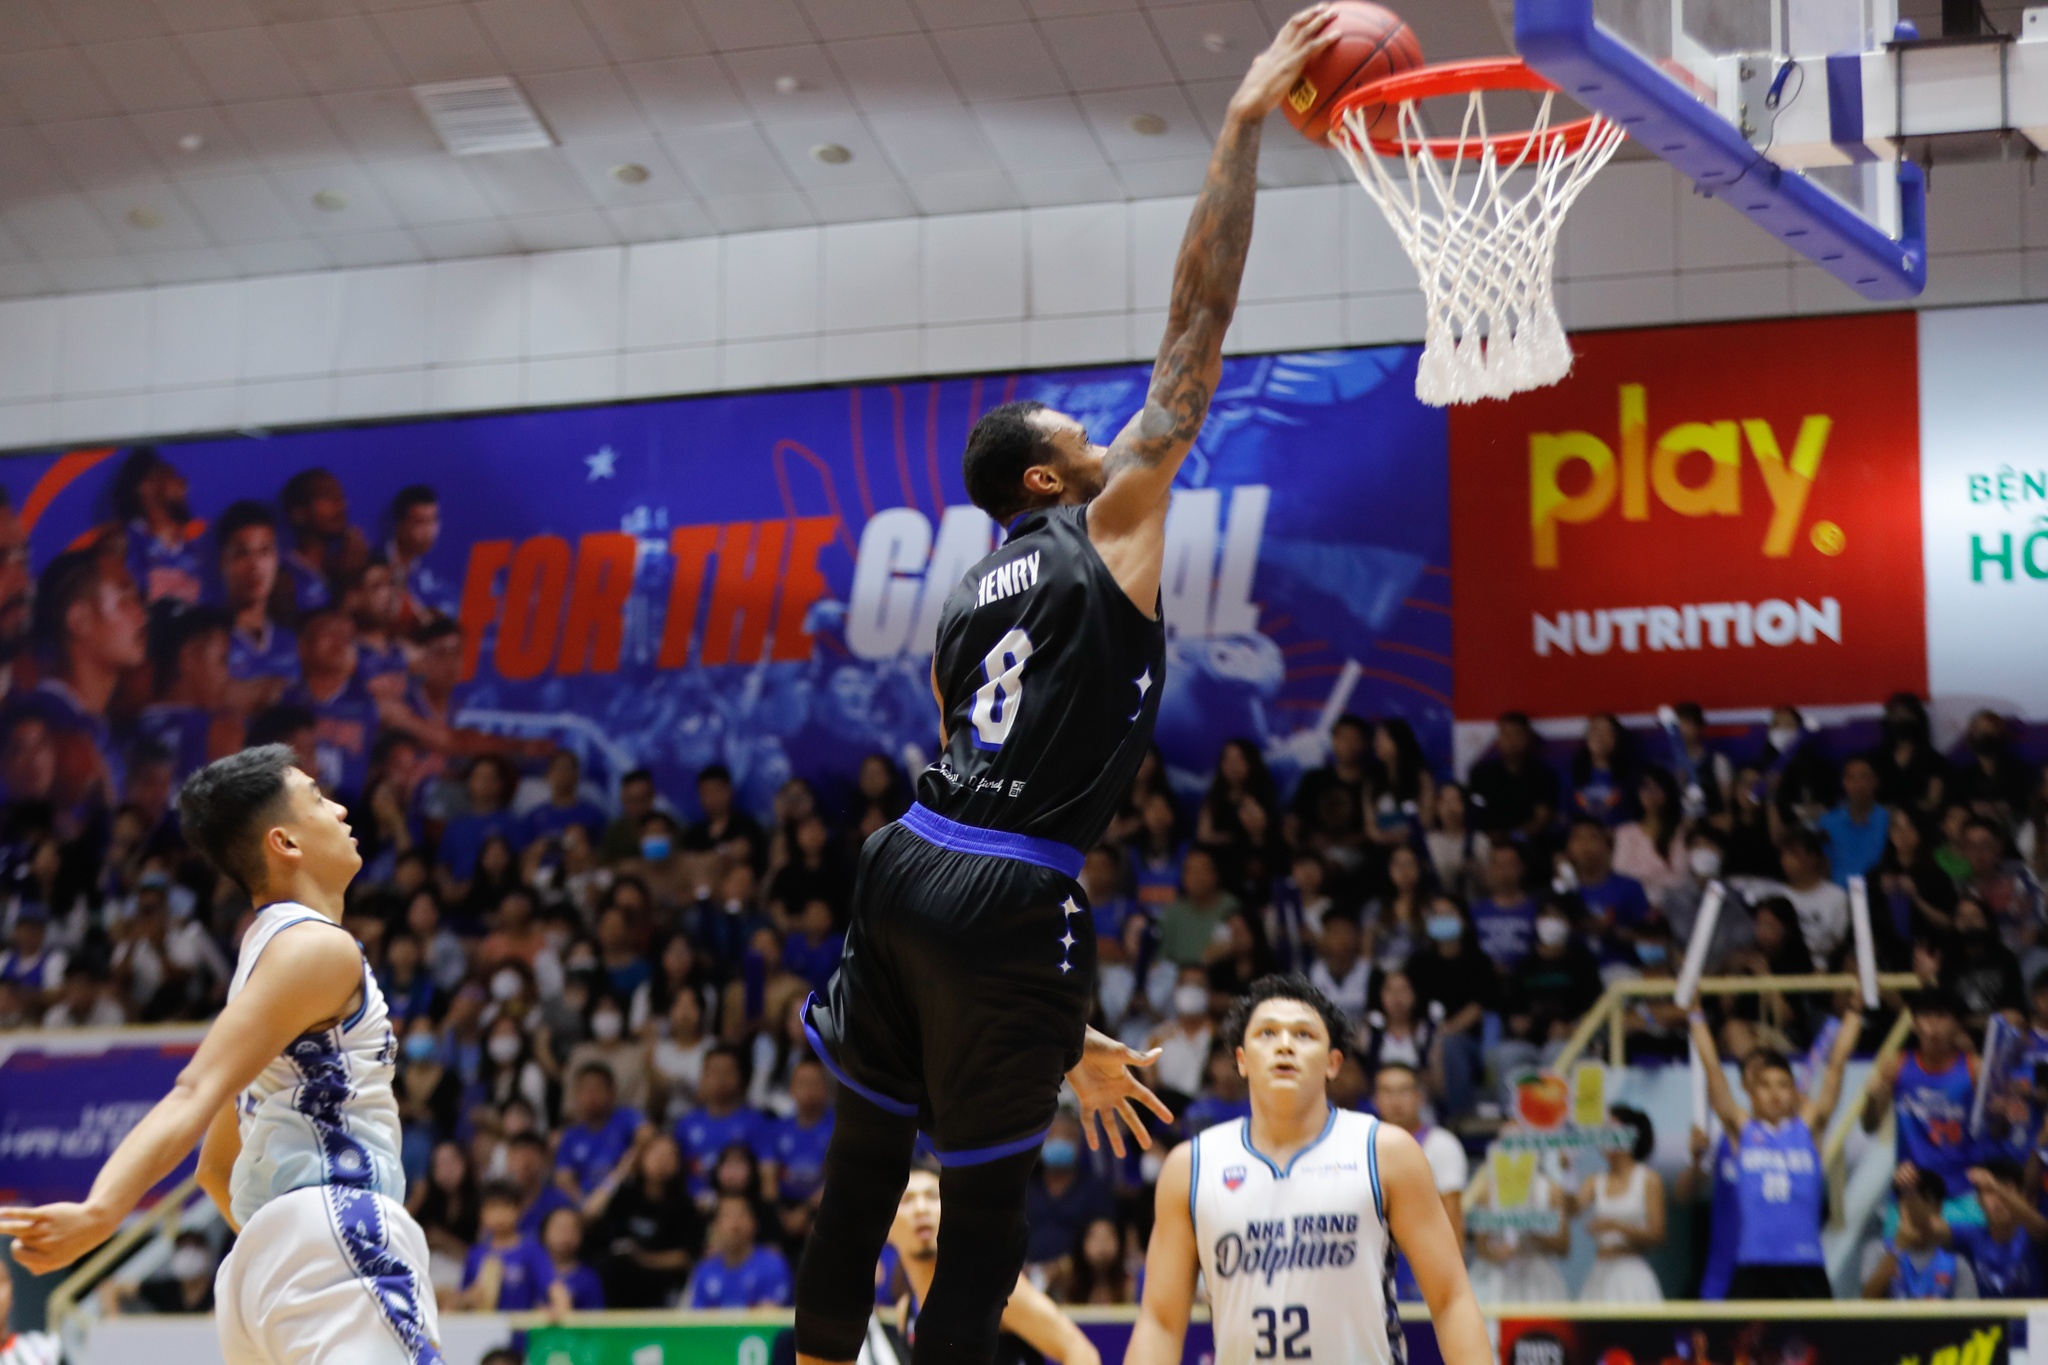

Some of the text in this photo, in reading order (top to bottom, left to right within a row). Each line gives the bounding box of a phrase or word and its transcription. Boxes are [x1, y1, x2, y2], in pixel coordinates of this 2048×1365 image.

[458, 529, 638, 683] FOR
[657, 514, 842, 669] THE
[974, 549, 1041, 611] HENRY
[1532, 596, 1842, 657] NUTRITION
[1215, 1232, 1356, 1285] Dolphins
[1252, 1304, 1312, 1359] 32
